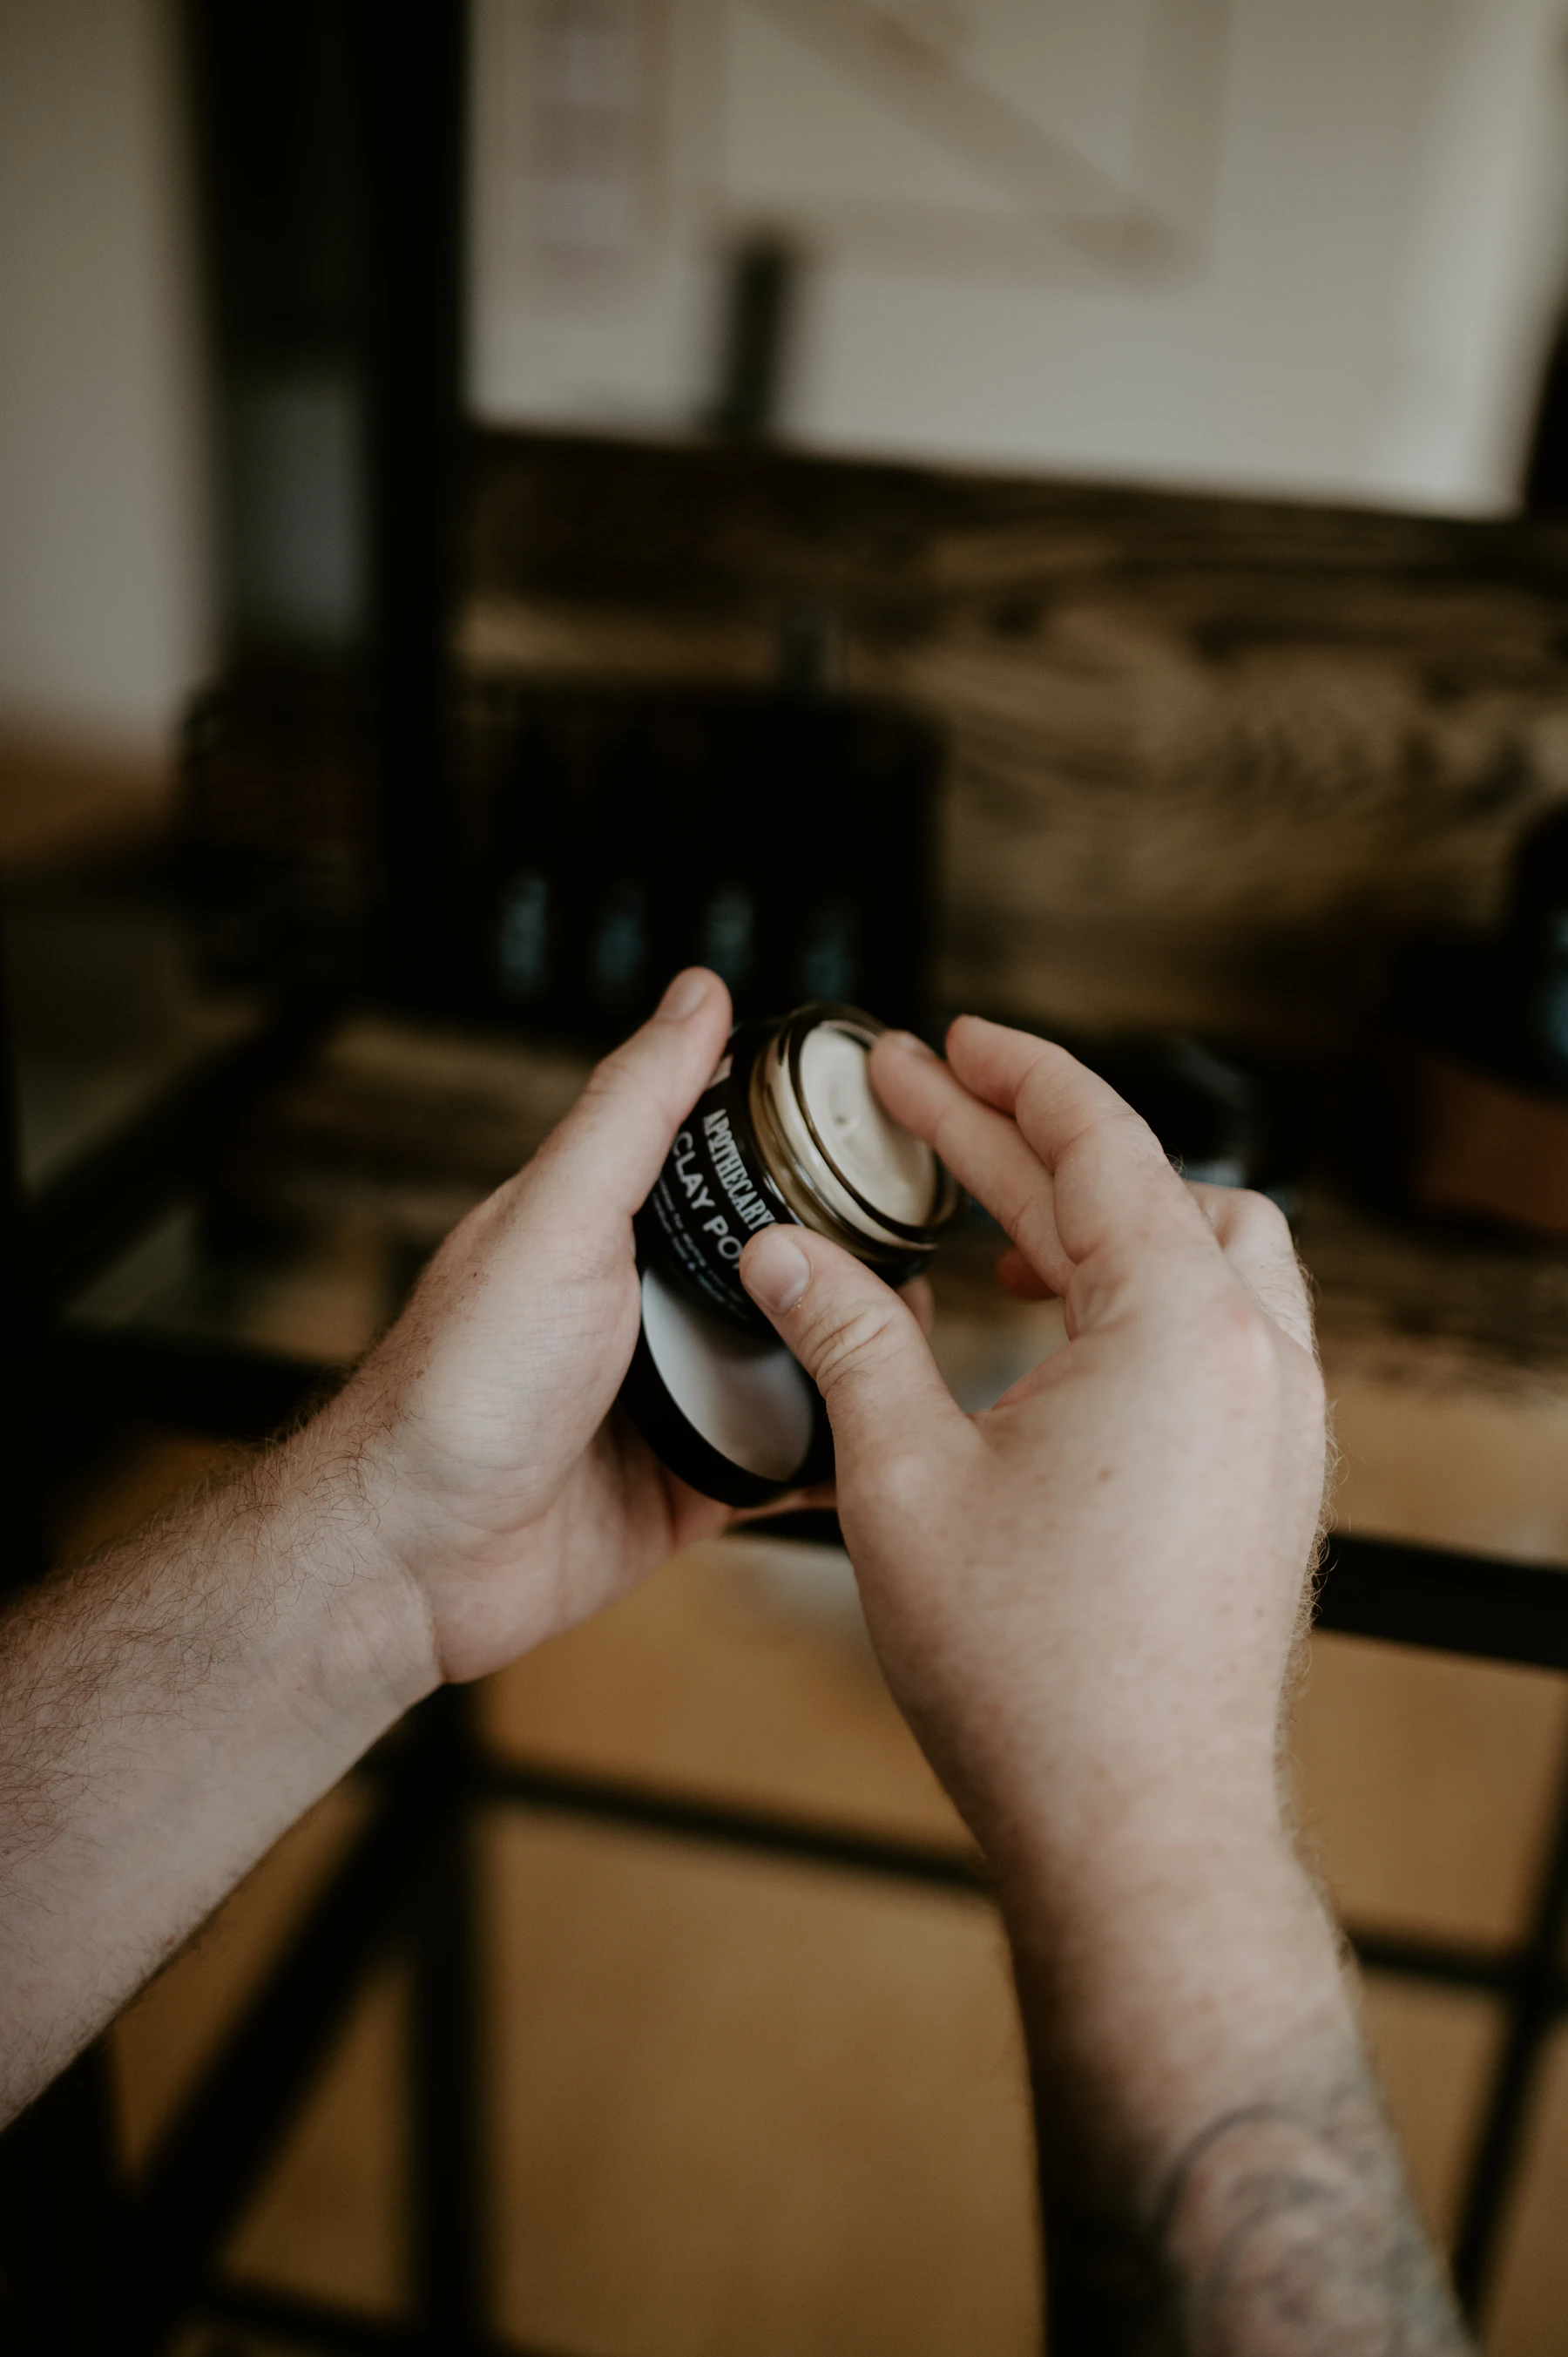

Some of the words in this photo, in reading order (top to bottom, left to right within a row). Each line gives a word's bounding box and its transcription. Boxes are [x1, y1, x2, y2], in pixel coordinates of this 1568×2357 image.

[673, 1131, 715, 1209] CLAY
[703, 1215, 743, 1269] PO
[703, 1108, 777, 1230] APOTHECARY
